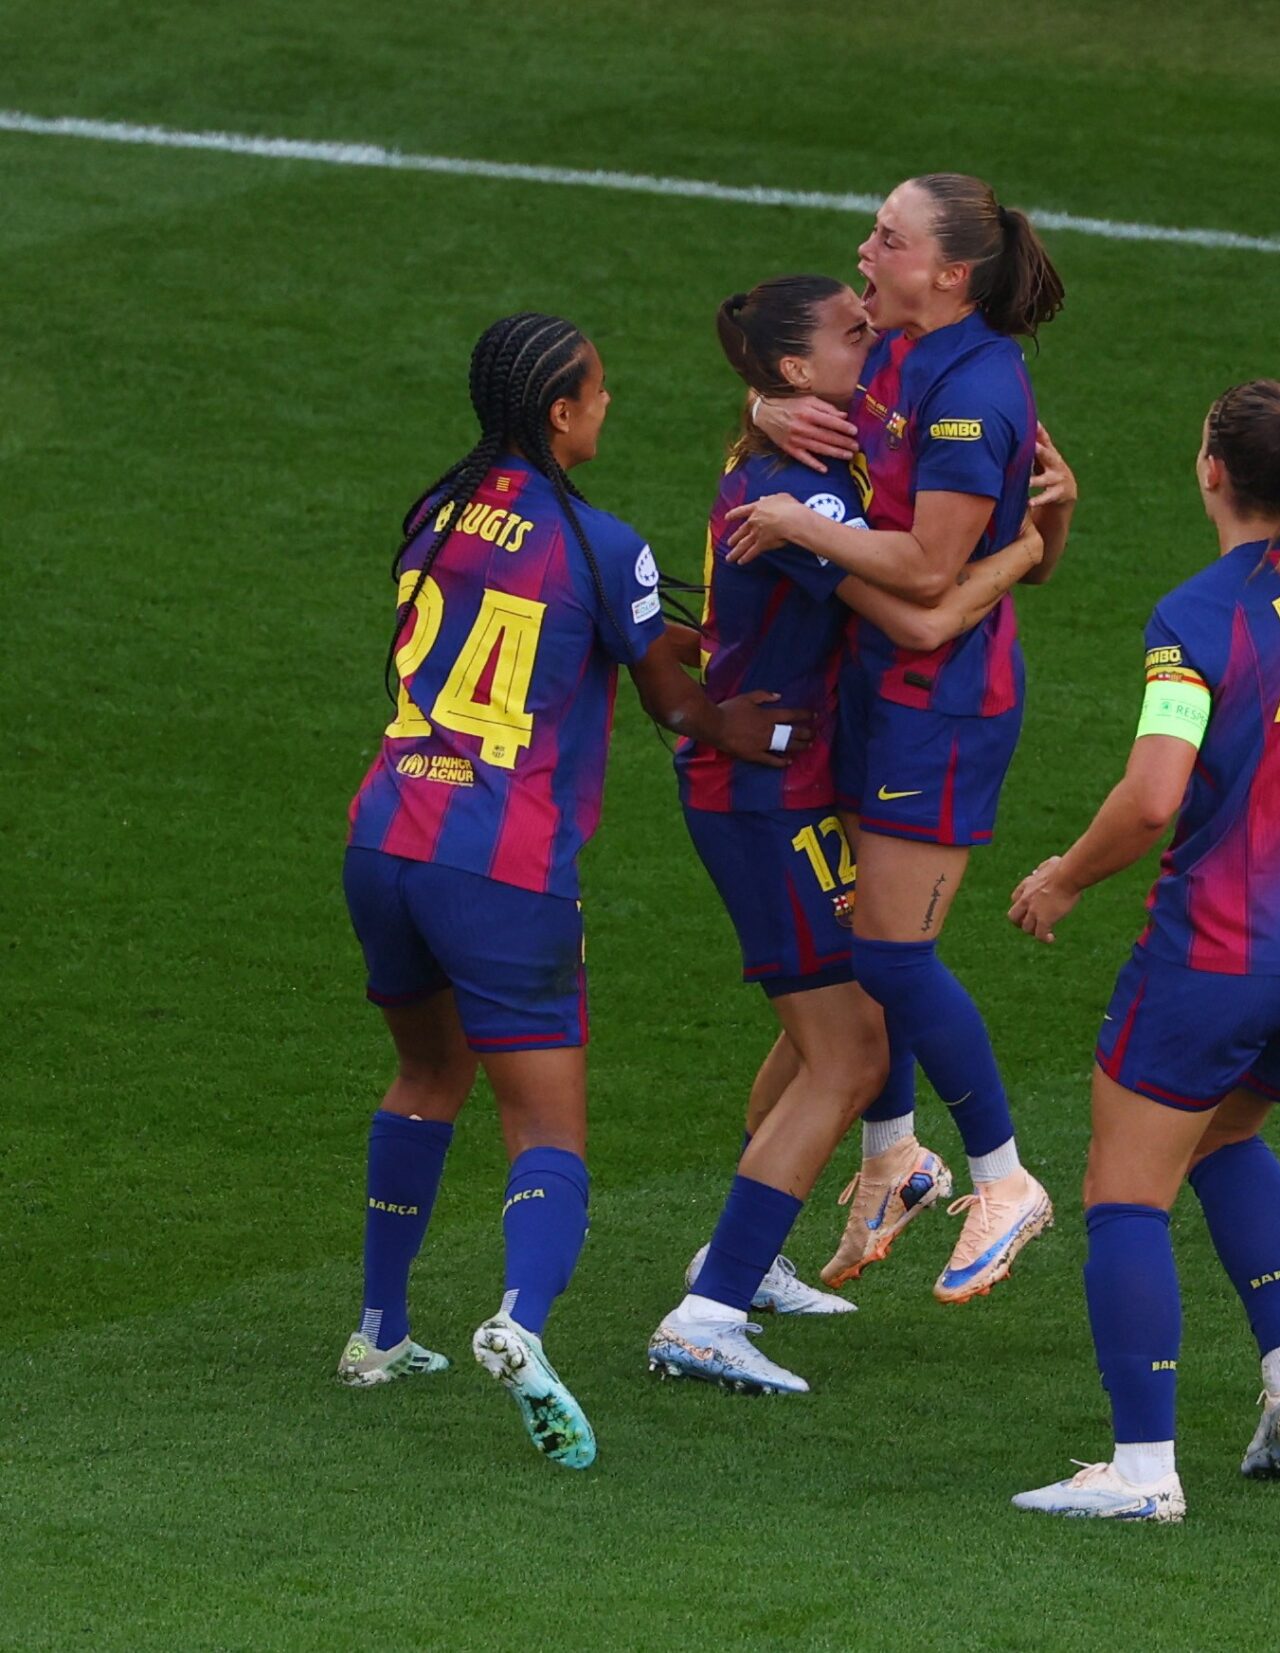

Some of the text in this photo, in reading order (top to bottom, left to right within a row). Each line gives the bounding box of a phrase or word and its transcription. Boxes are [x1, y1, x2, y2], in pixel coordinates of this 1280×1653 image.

[930, 422, 981, 437] BIMBO
[1145, 648, 1181, 665] MBO
[384, 569, 547, 769] 24
[431, 755, 472, 770] UNHCR
[426, 767, 474, 782] ACNUR
[791, 815, 857, 892] 12
